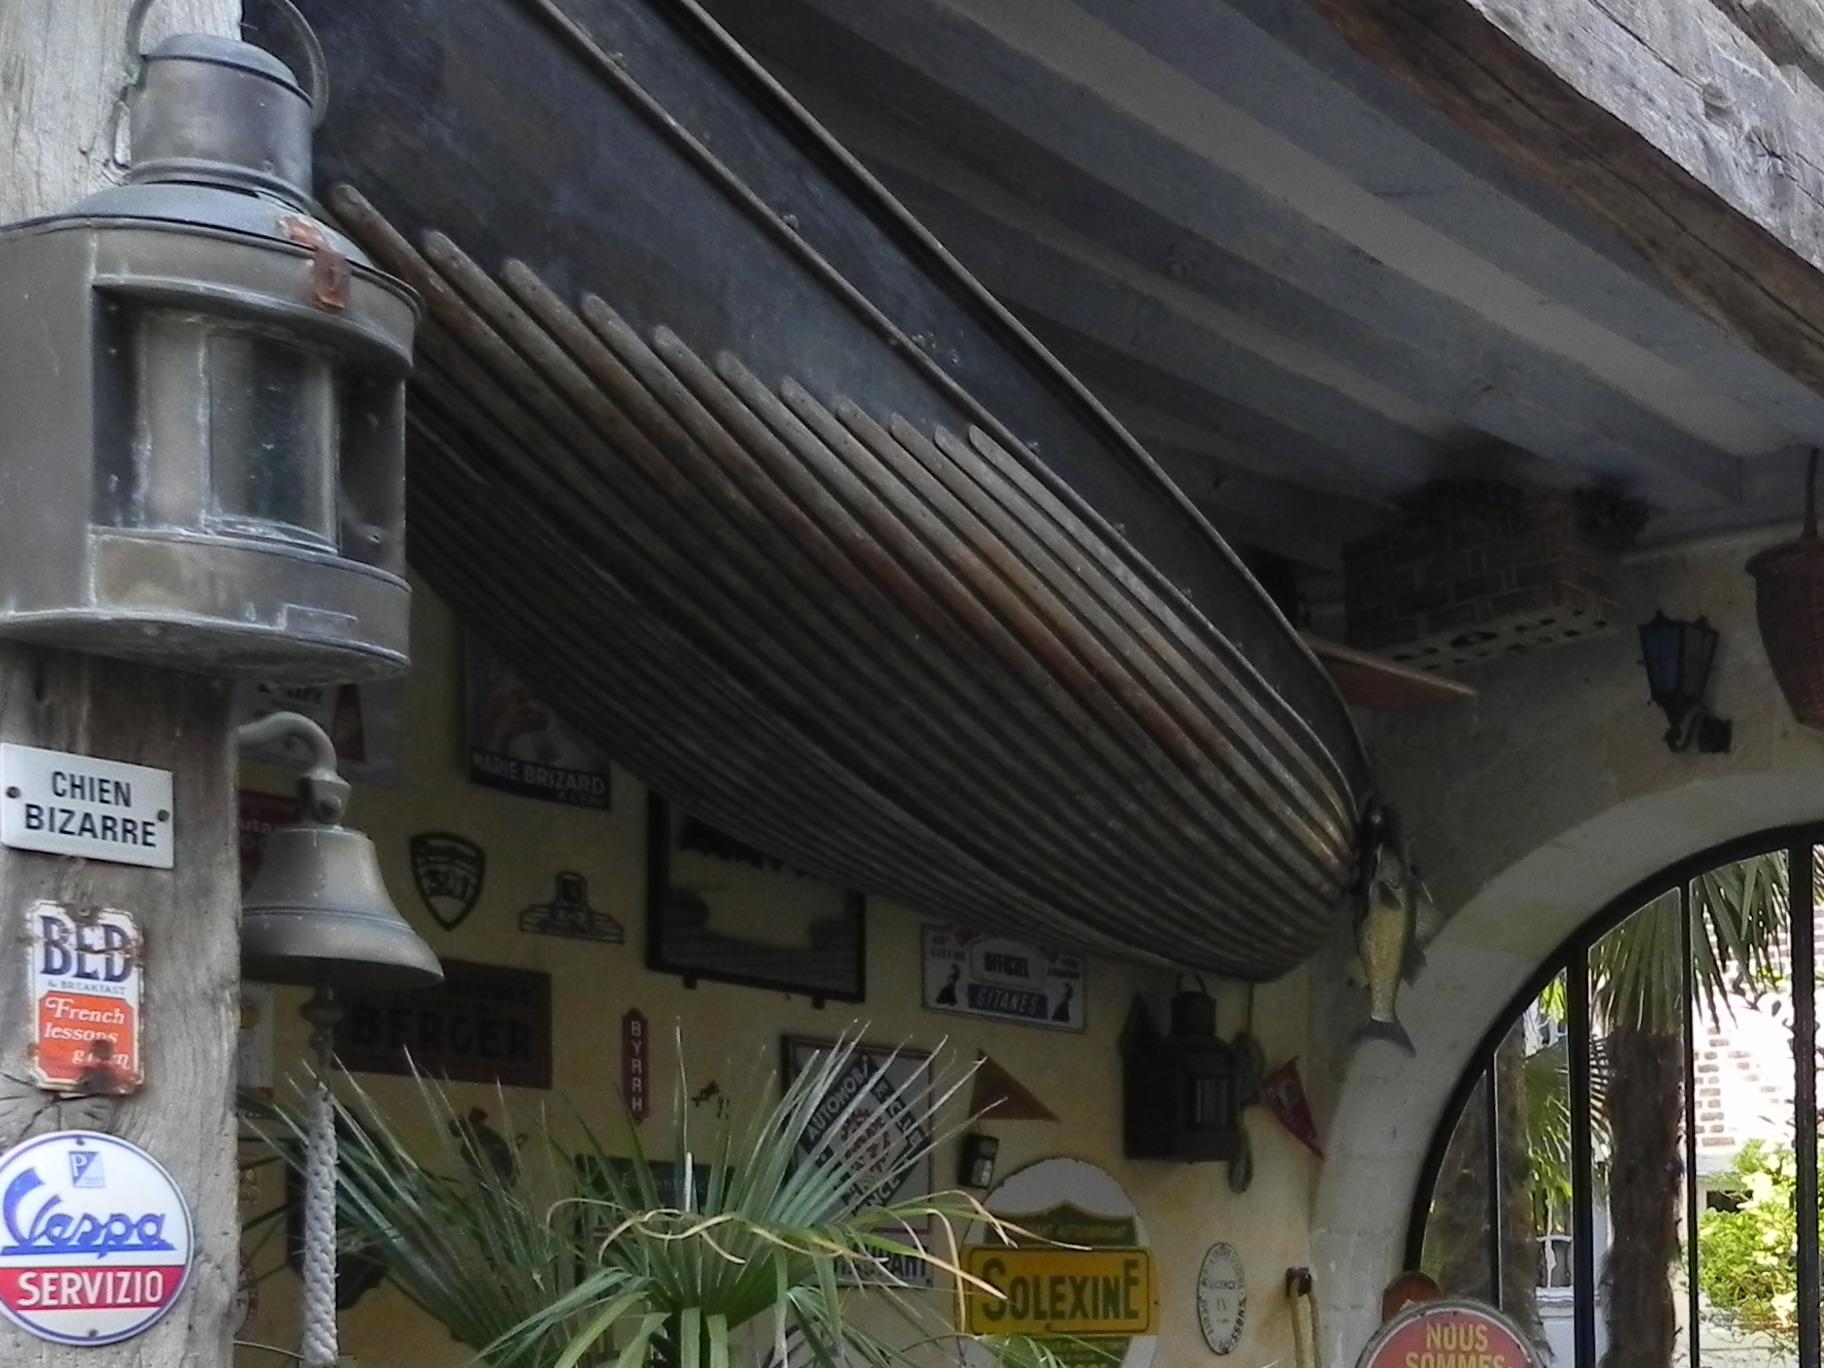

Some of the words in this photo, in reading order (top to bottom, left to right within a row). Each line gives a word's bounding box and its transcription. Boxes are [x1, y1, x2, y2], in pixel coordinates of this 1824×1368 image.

[52, 771, 132, 808] CHIEN
[471, 752, 520, 781] MARIE
[523, 764, 606, 795] BRIZARD
[25, 803, 157, 848] BIZARRE
[40, 914, 133, 984] BED
[60, 981, 127, 995] BREAKFAST
[976, 987, 1040, 1015] GITANES
[45, 996, 125, 1024] French
[44, 1022, 119, 1043] lessons
[350, 1002, 532, 1062] BERGER
[631, 1020, 642, 1111] BYRRH
[1, 1167, 176, 1260] Vespa
[17, 1270, 164, 1307] SERVIZIO
[981, 1257, 1140, 1322] SOLEXINE
[1426, 1321, 1488, 1350] NOUS
